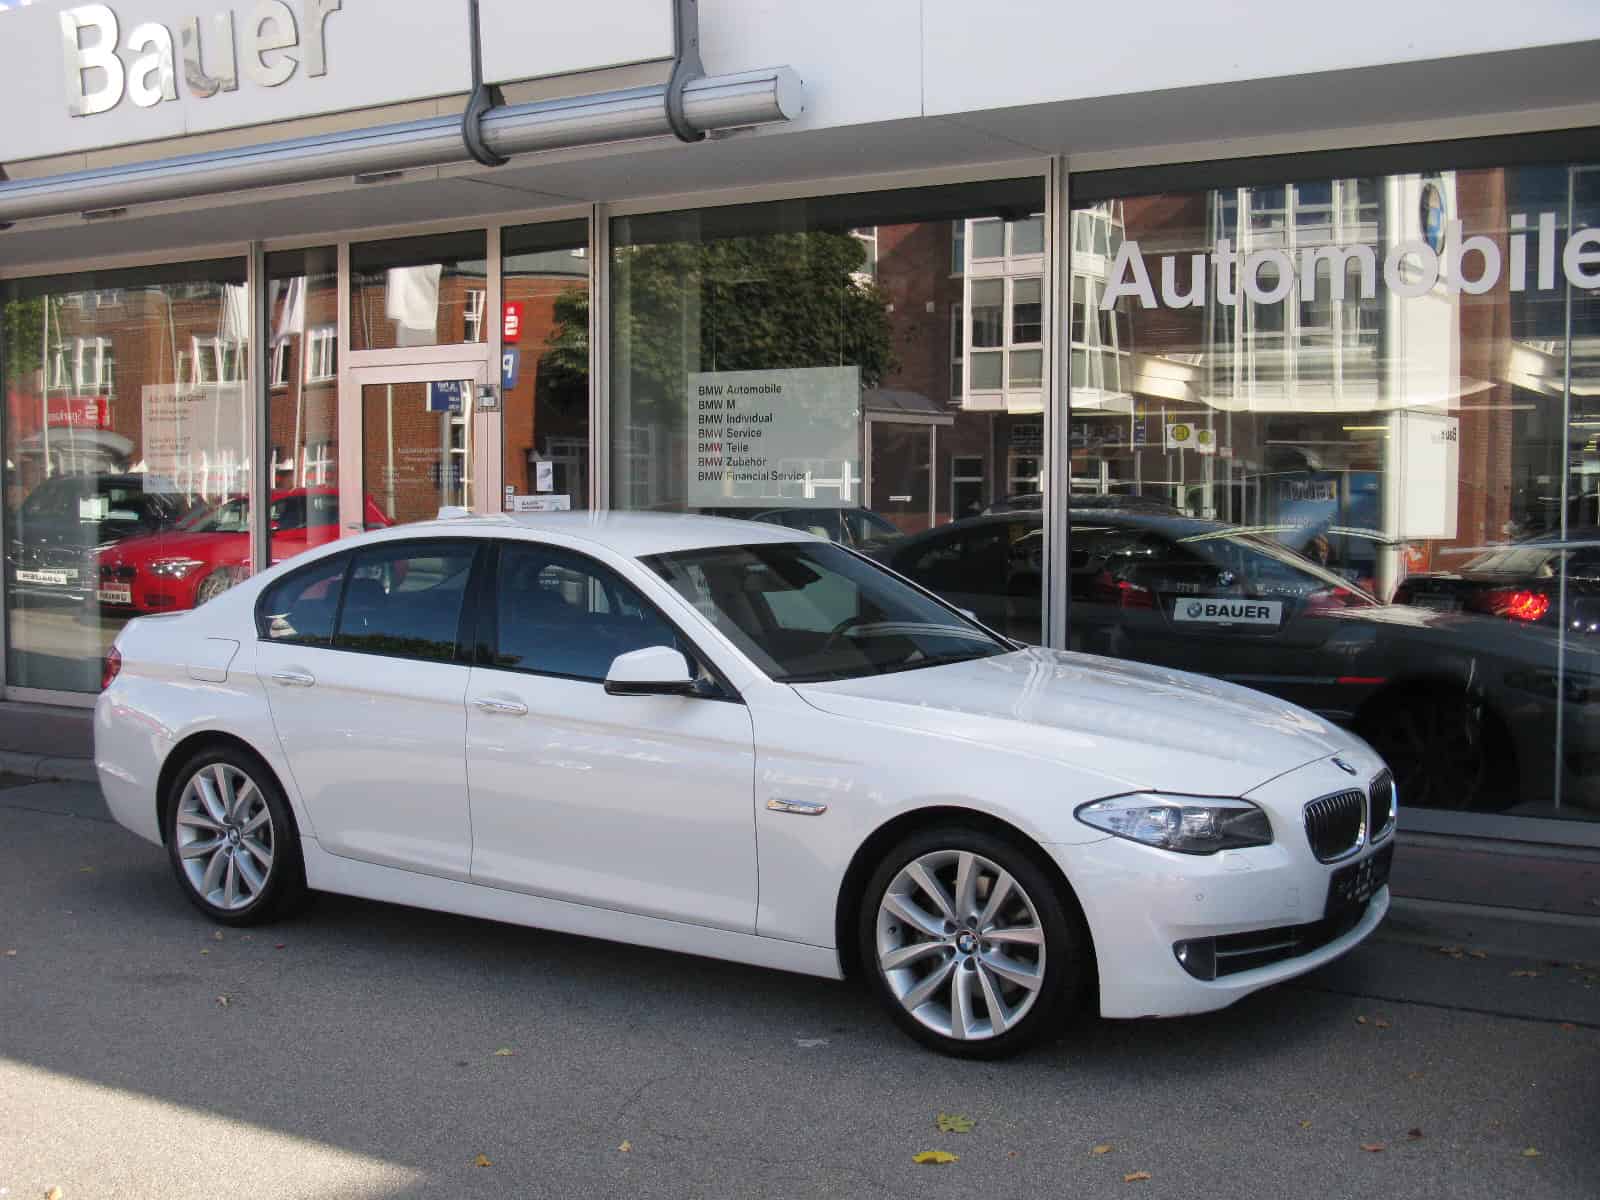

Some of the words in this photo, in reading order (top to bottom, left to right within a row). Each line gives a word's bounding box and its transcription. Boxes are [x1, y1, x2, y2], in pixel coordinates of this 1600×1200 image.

[58, 0, 342, 118] Bauer
[698, 386, 723, 396] BMW
[727, 384, 782, 394] Automobile
[698, 400, 723, 409] BMW
[727, 399, 736, 409] M
[698, 415, 723, 424] BMW
[727, 412, 773, 424] Individual
[698, 429, 723, 438] BMW
[727, 428, 762, 438] Service
[698, 443, 723, 453] BMW
[727, 442, 749, 453] Teile
[697, 457, 723, 467] BMW
[698, 471, 723, 481] BMW
[726, 471, 769, 481] Financial
[1205, 604, 1271, 619] BAUER
